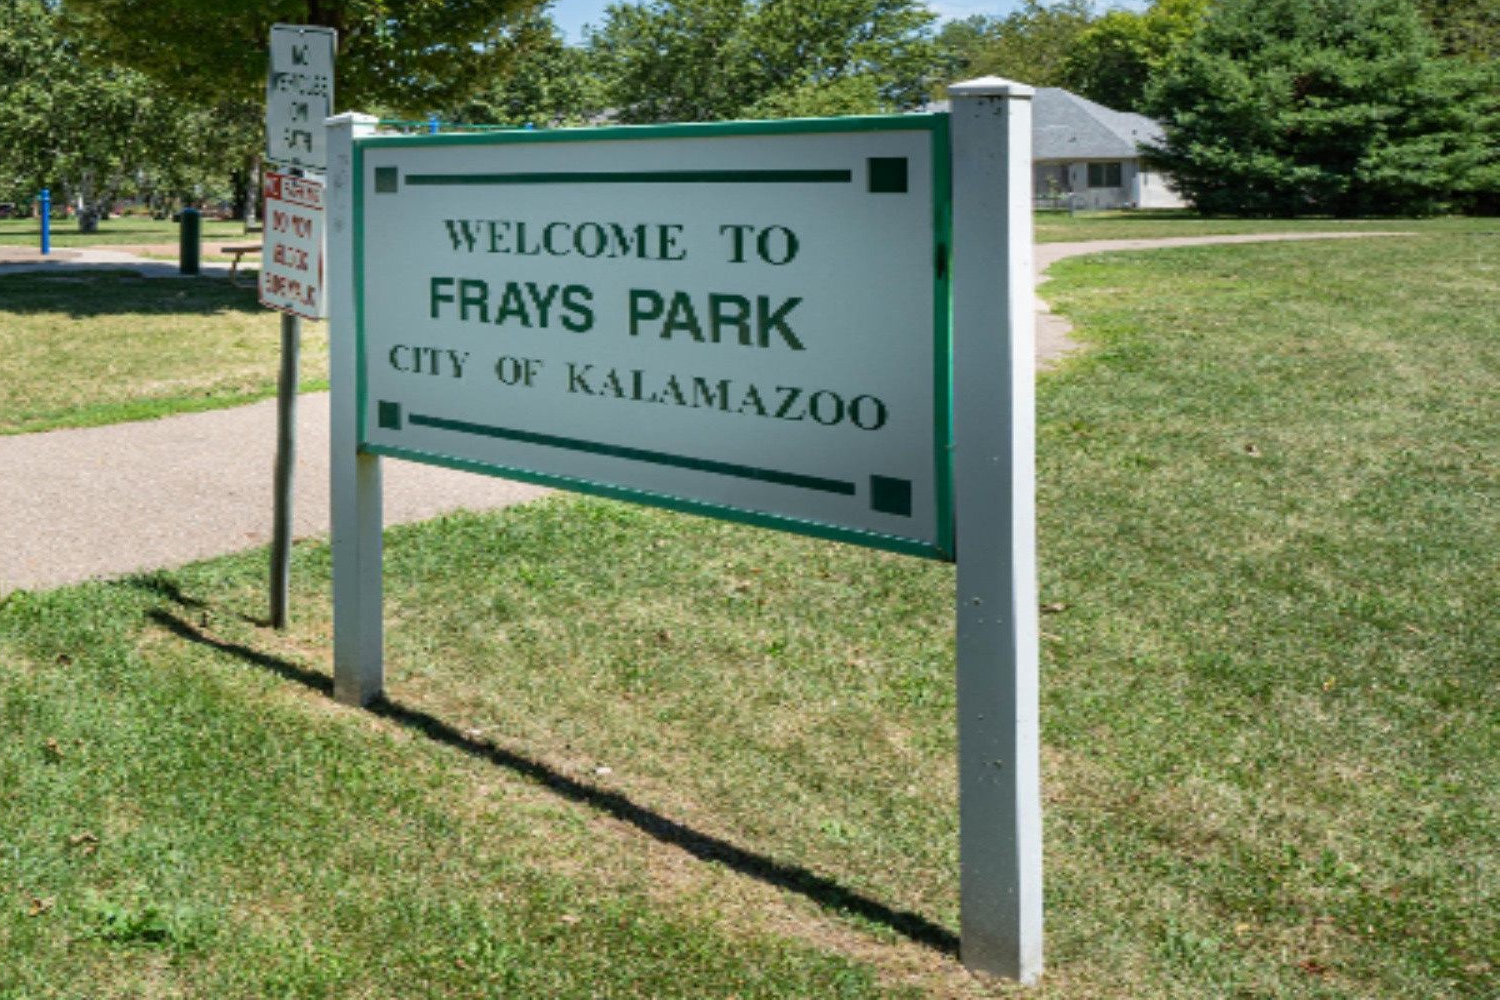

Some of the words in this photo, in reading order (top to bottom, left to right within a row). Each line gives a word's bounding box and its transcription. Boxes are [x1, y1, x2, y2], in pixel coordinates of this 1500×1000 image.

[443, 218, 688, 262] WELCOME
[719, 224, 800, 266] TO
[429, 276, 595, 334] FRAYS
[628, 288, 807, 352] PARK
[388, 343, 471, 379] CITY
[494, 355, 543, 388] OF
[566, 361, 888, 431] KALAMAZOO
